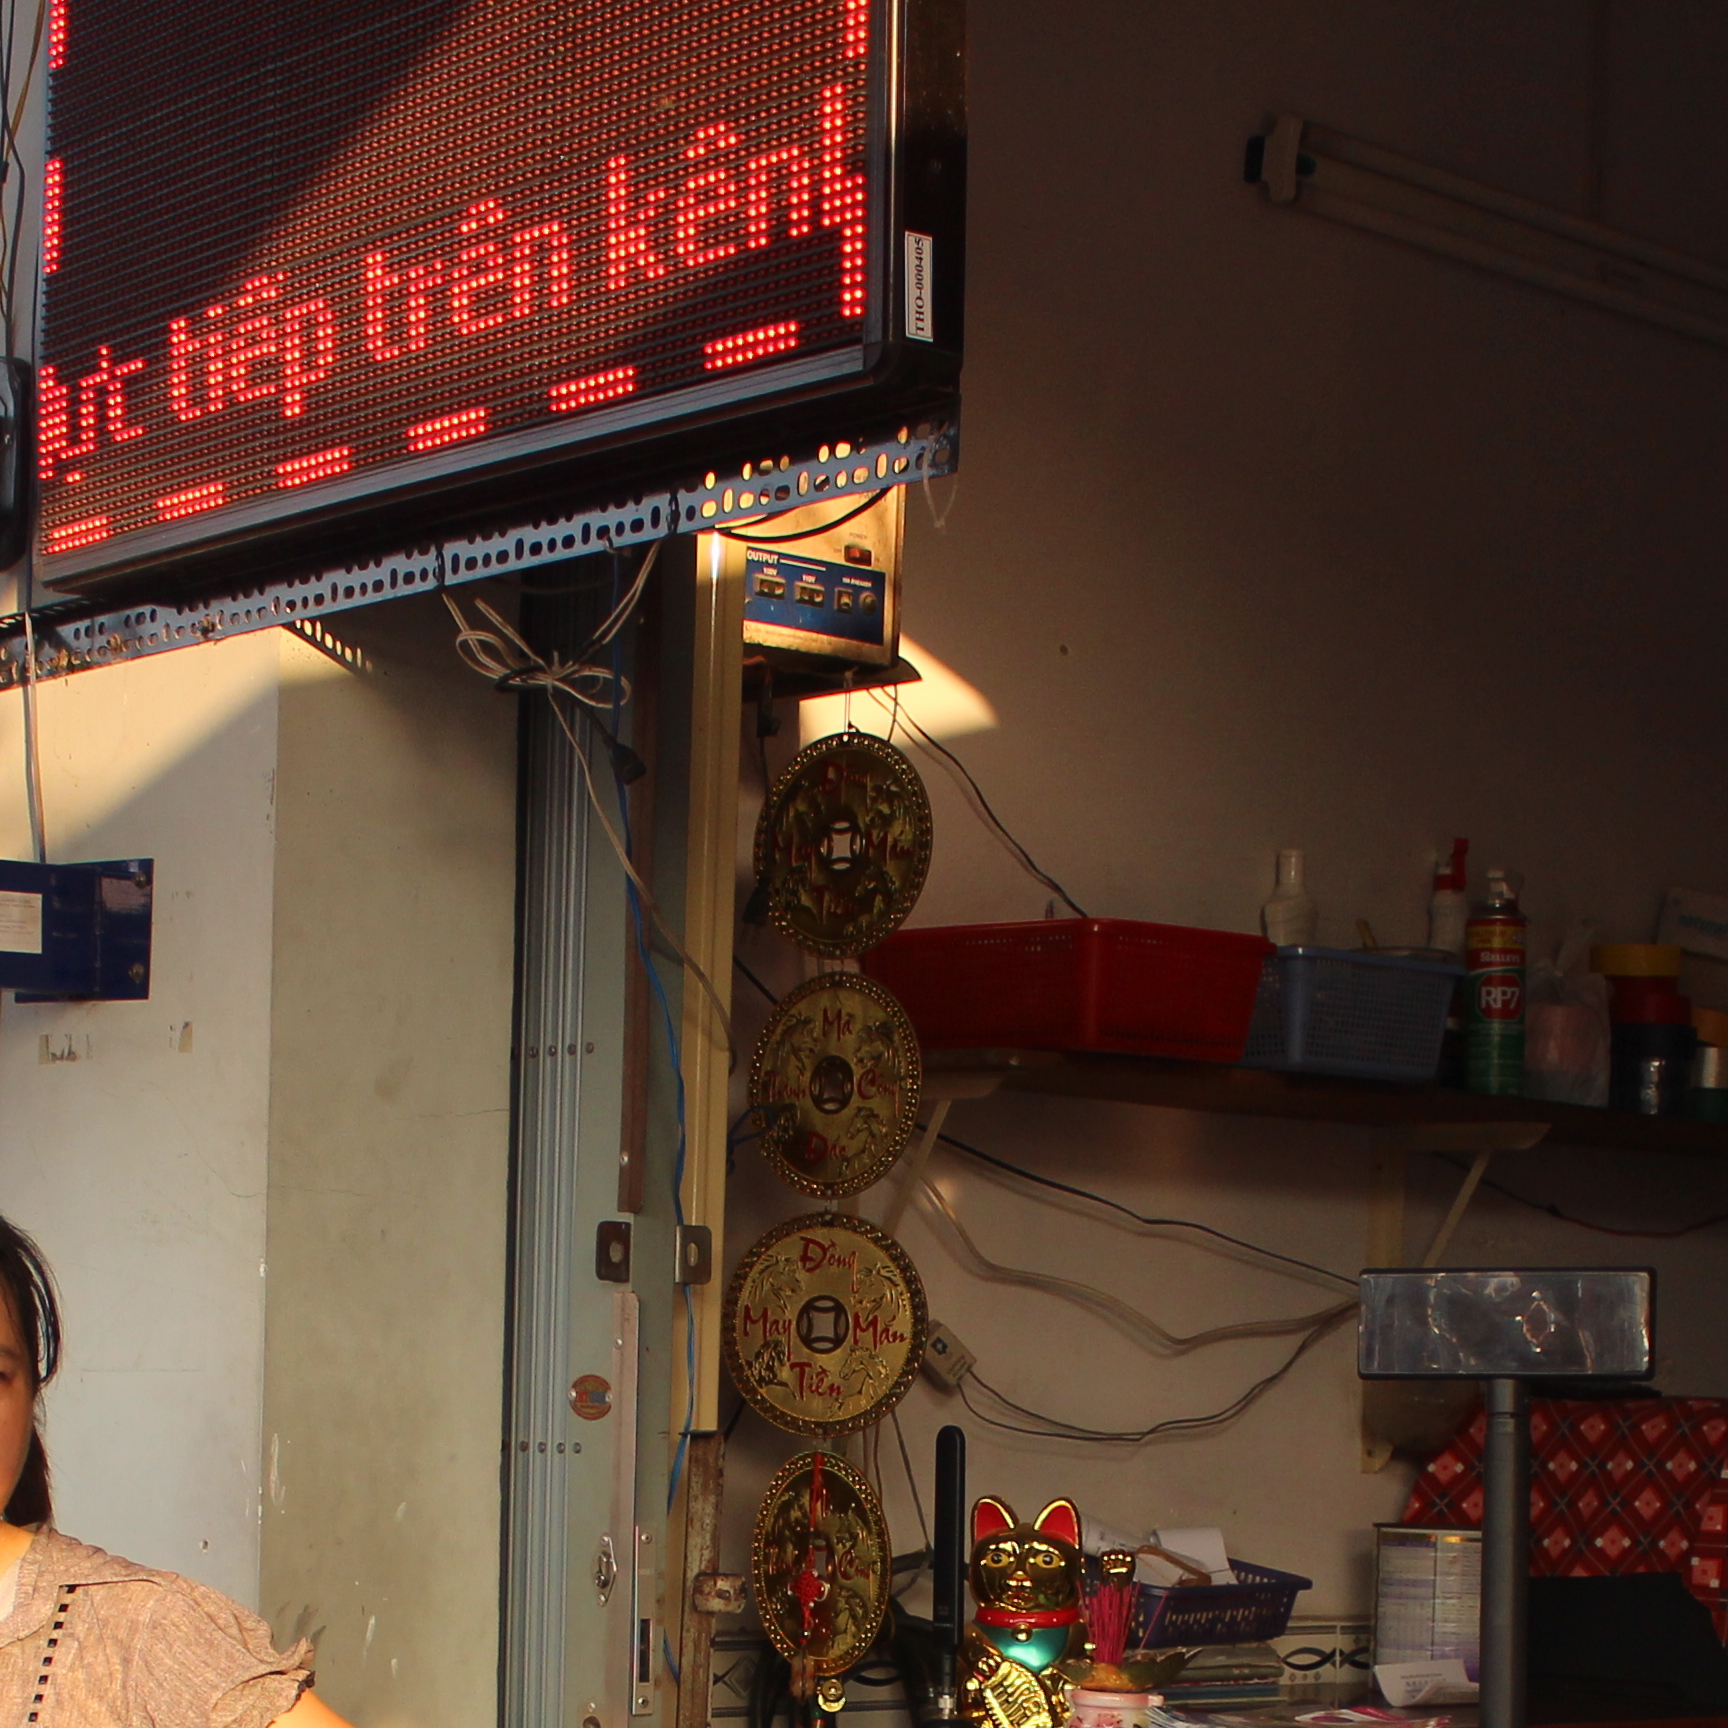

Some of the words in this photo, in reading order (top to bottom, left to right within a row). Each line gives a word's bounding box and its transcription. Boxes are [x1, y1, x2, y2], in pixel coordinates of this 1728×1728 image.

[168, 271, 334, 423] tiếp
[364, 198, 571, 362] trên
[1480, 986, 1520, 1010] RP7
